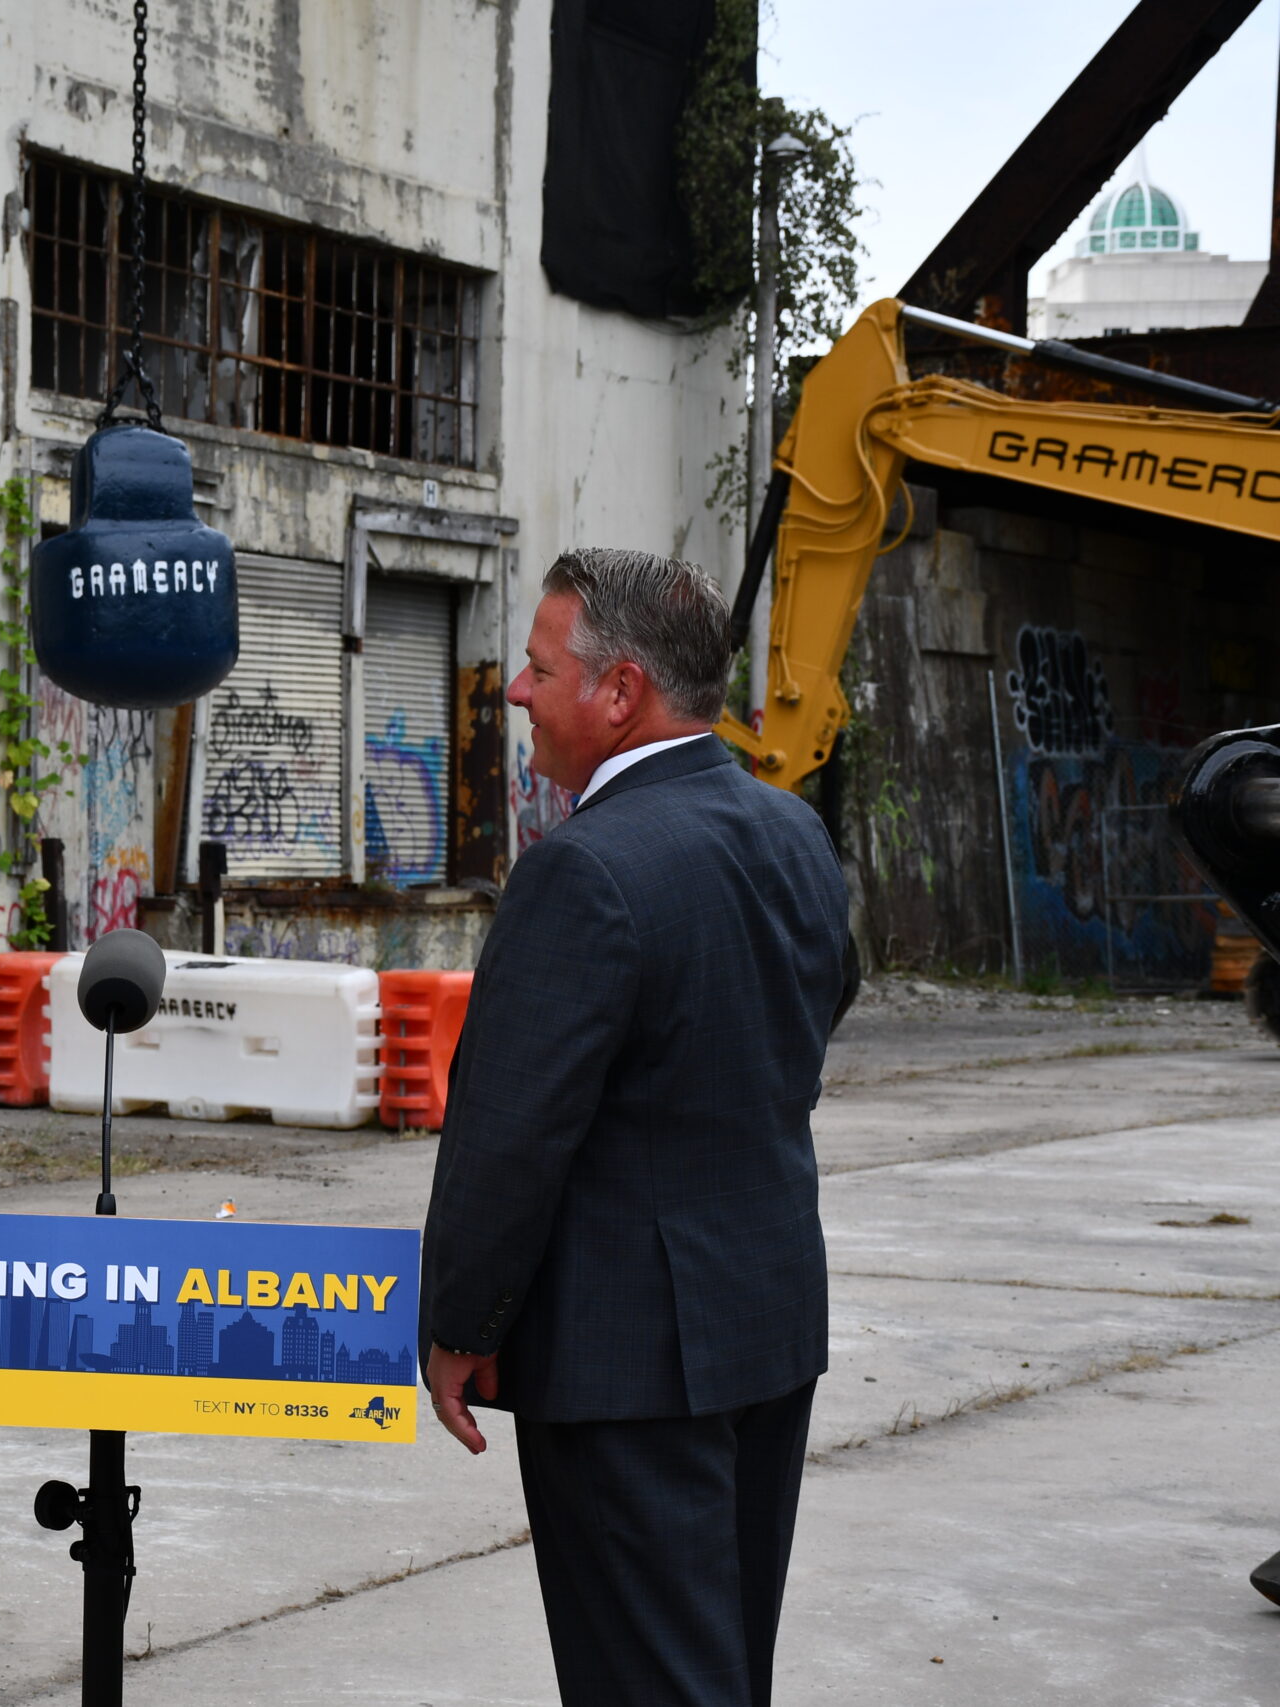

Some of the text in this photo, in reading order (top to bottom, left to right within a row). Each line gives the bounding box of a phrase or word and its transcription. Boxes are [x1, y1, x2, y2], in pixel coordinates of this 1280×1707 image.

[425, 482, 436, 503] H
[69, 558, 219, 599] GRAMERCY
[158, 998, 237, 1021] RAMERCY
[106, 1264, 160, 1303] IN
[176, 1268, 399, 1312] ALBANY
[193, 1399, 329, 1418] TEXT NY TO 81336
[354, 1407, 401, 1420] WE ARE NY
